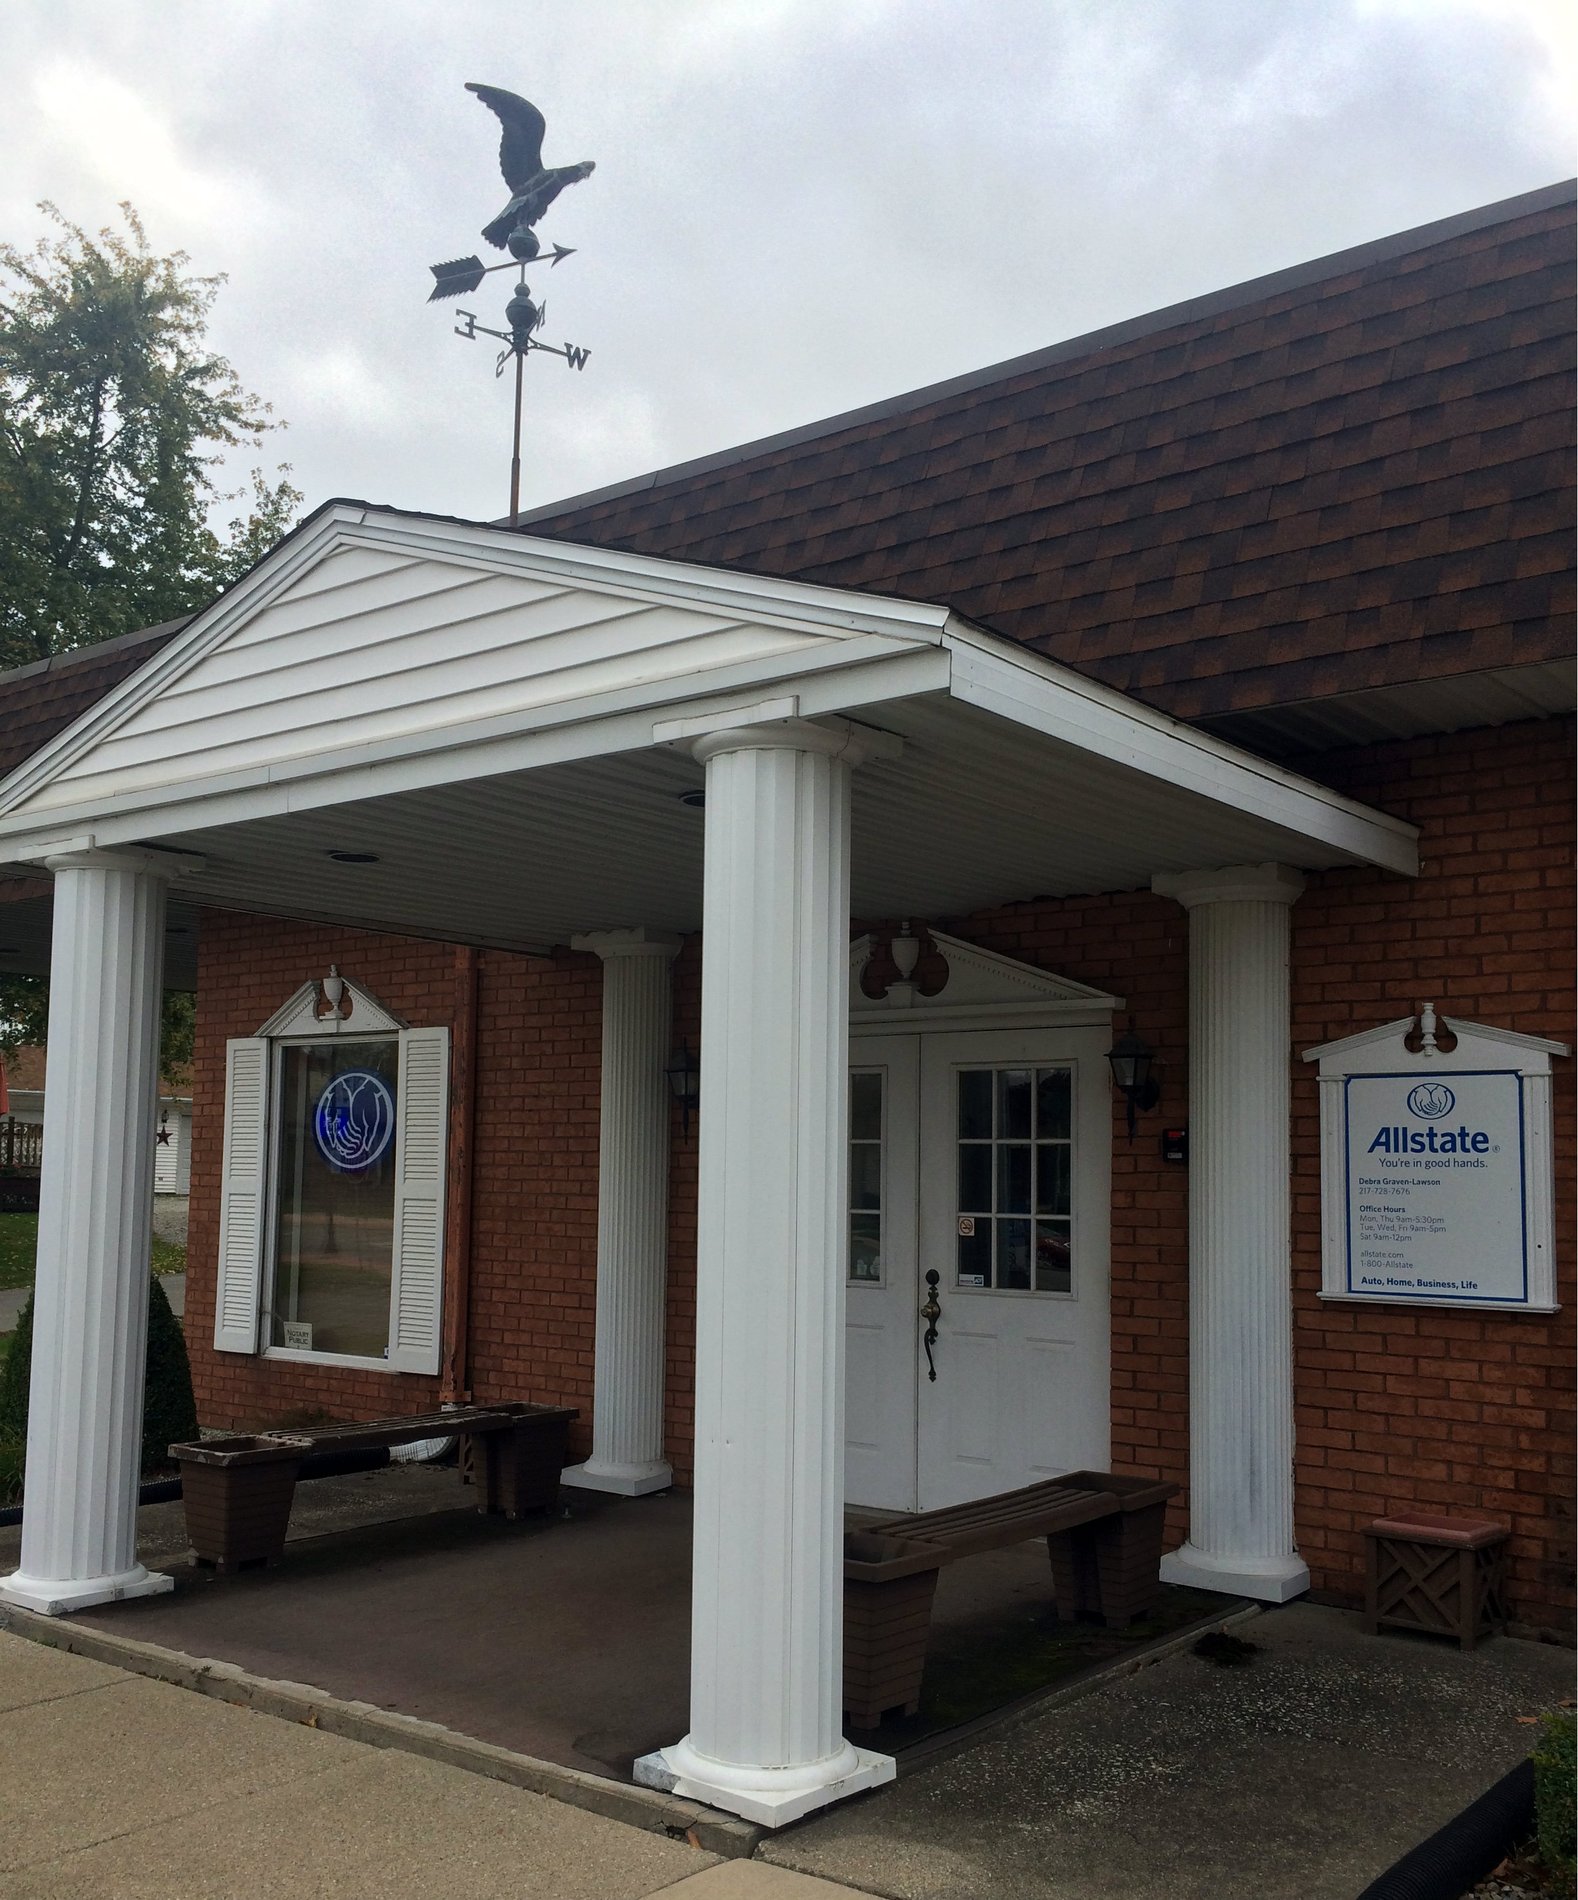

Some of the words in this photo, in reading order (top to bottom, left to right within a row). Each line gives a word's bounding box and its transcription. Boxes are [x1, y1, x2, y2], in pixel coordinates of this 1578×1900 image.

[564, 342, 592, 372] W
[1367, 1126, 1489, 1154] Allstate
[1379, 1158, 1410, 1168] You're
[1413, 1158, 1422, 1168] in
[1425, 1158, 1450, 1169] good
[1453, 1157, 1488, 1168] hands.
[1359, 1177, 1381, 1185] Debra
[1383, 1177, 1441, 1186] Graven-Lawson
[1360, 1205, 1382, 1213] Office
[1383, 1205, 1406, 1213] Hours
[1380, 1215, 1394, 1223] Thu
[1360, 1232, 1371, 1240] Sat
[1373, 1233, 1412, 1242] 9am-12pm
[1361, 1276, 1385, 1286] Auto,
[1386, 1278, 1414, 1288] Home,
[1417, 1279, 1459, 1290] Business,
[1461, 1281, 1478, 1289] Life
